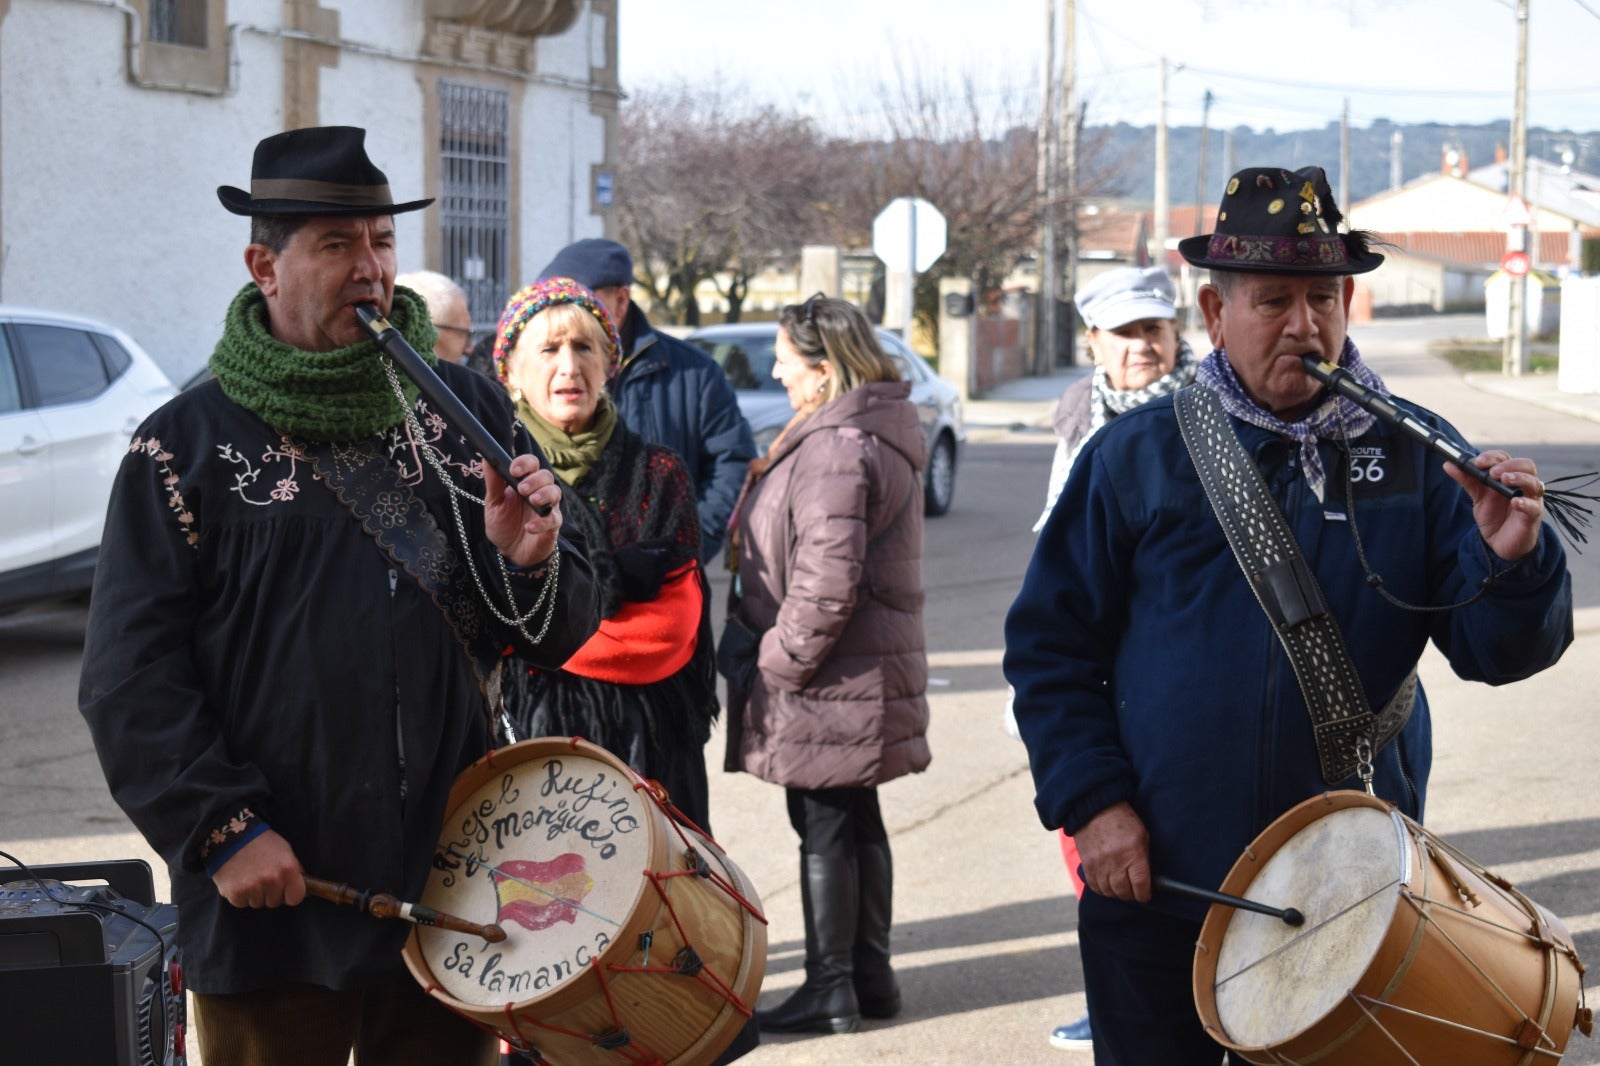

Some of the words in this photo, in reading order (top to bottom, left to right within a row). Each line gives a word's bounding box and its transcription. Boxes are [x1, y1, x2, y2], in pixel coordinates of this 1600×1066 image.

[1351, 458, 1384, 482] 66
[541, 760, 640, 834] Rufino
[444, 932, 610, 993] Salamanca
